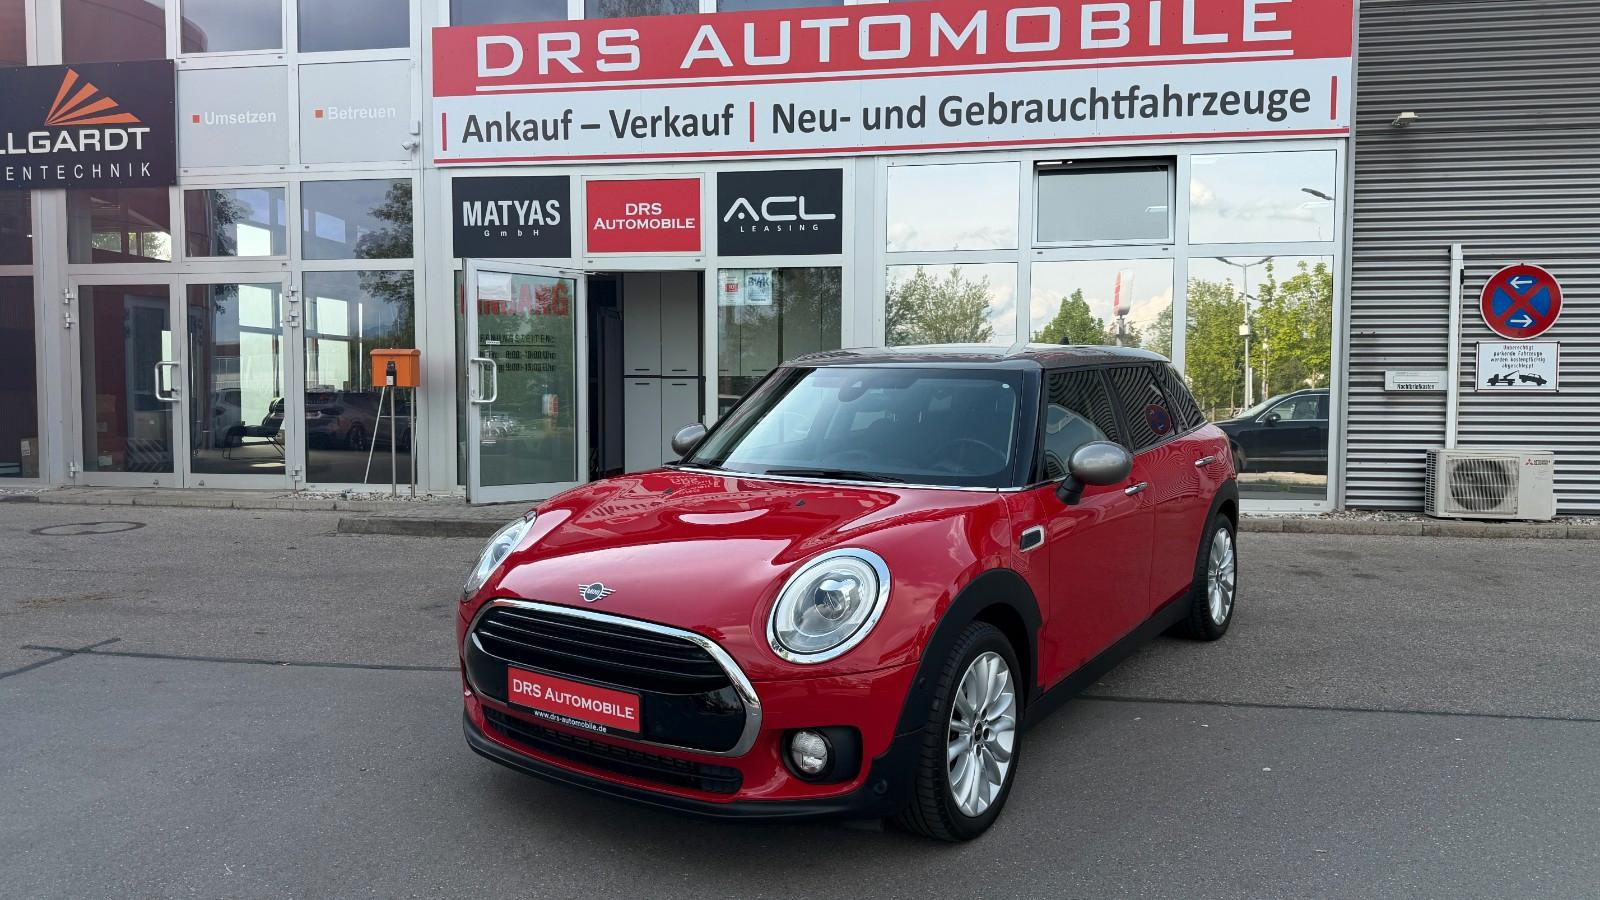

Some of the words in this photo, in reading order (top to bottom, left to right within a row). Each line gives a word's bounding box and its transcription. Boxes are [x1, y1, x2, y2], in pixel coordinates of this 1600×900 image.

[476, 29, 641, 78] DRS
[680, 0, 1293, 69] AUTOMOBILE
[204, 110, 277, 125] Umsetzen
[327, 104, 396, 120] Betreuen
[461, 109, 573, 144] Ankauf
[608, 104, 734, 138] Verkauf
[773, 104, 851, 134] Neu-
[862, 95, 926, 131] und
[938, 84, 1311, 126] Gebrauchtfahrzeuge
[0, 127, 150, 155] LGARDT
[462, 199, 561, 227] MATYAS
[625, 202, 663, 216] DRS
[723, 195, 837, 223] ACL
[740, 223, 819, 233] LEASING
[512, 678, 542, 698] DRS
[534, 710, 607, 733] www.drs-automobile.de
